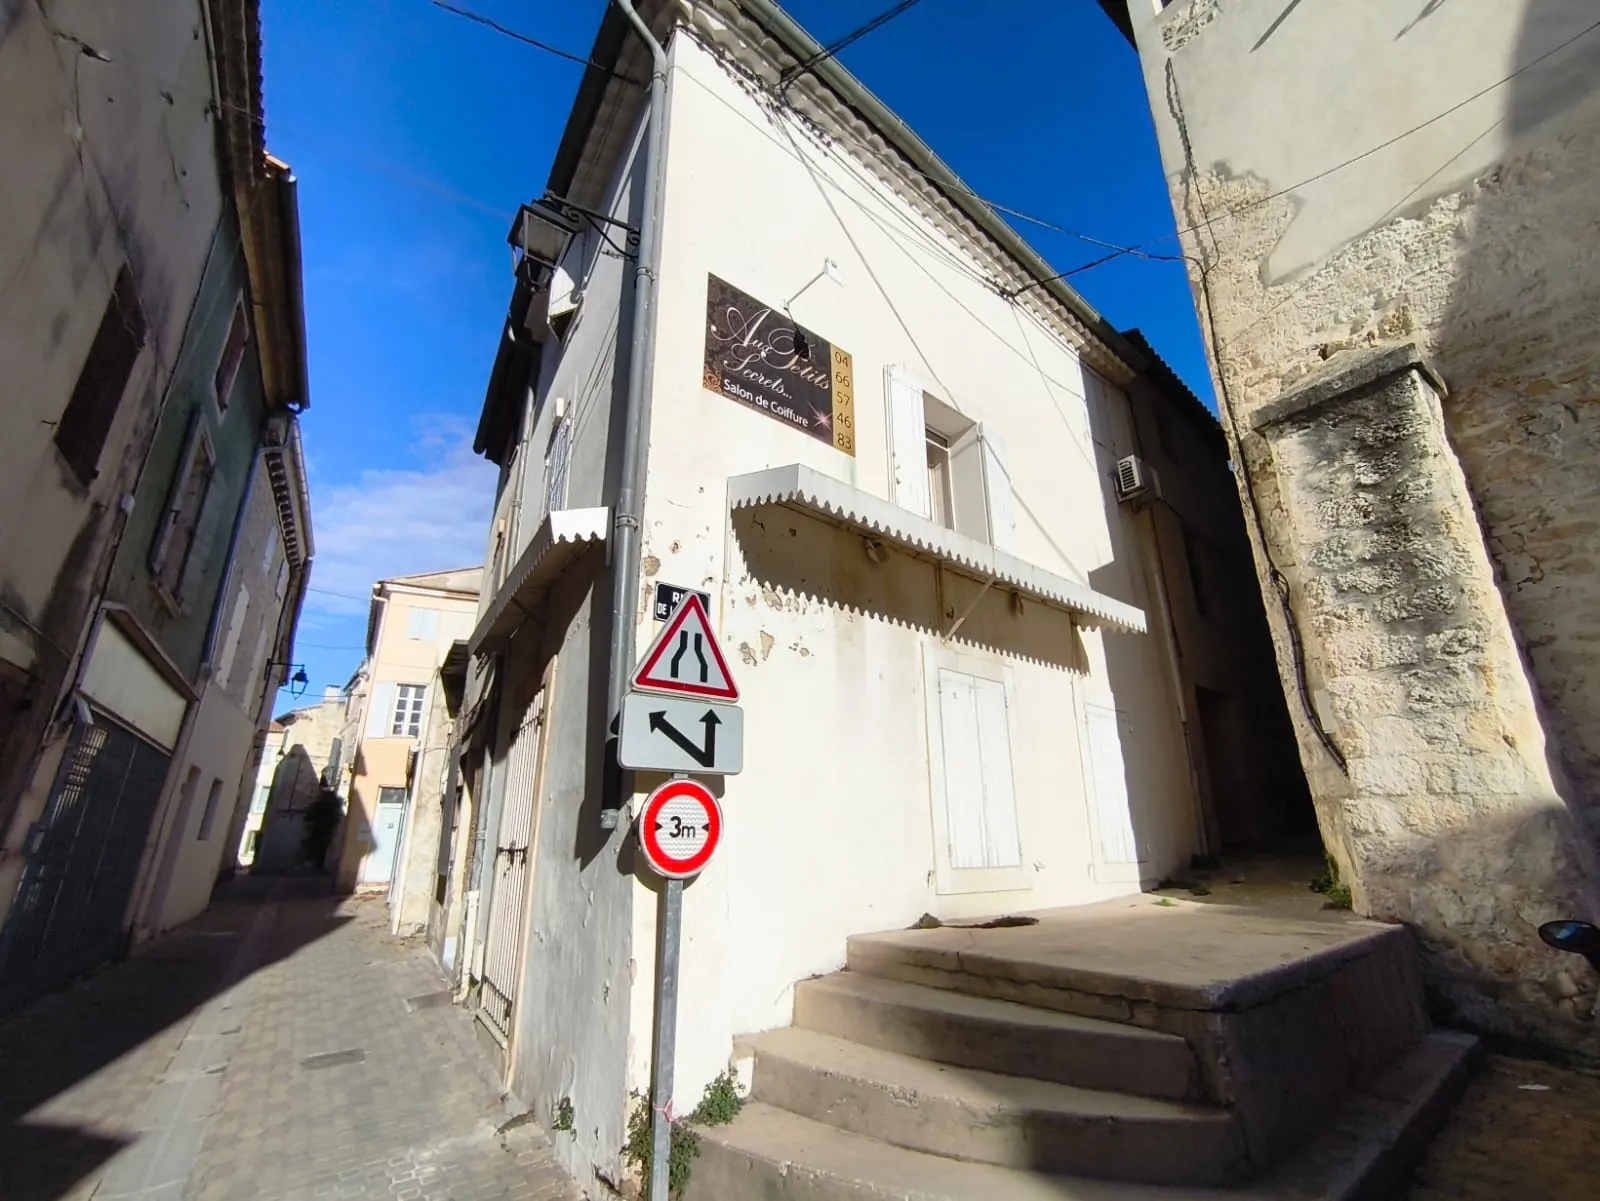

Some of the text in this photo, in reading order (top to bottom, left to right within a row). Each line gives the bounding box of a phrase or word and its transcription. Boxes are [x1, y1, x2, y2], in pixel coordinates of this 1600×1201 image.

[711, 307, 829, 389] Aux Petits
[834, 351, 848, 369] 04
[835, 371, 850, 388] 66
[723, 379, 809, 427] Salon de Coiffure
[836, 391, 850, 406] 57
[836, 412, 852, 429] 46
[837, 432, 852, 450] 83
[657, 602, 668, 616] DE
[669, 815, 696, 838] 3m
